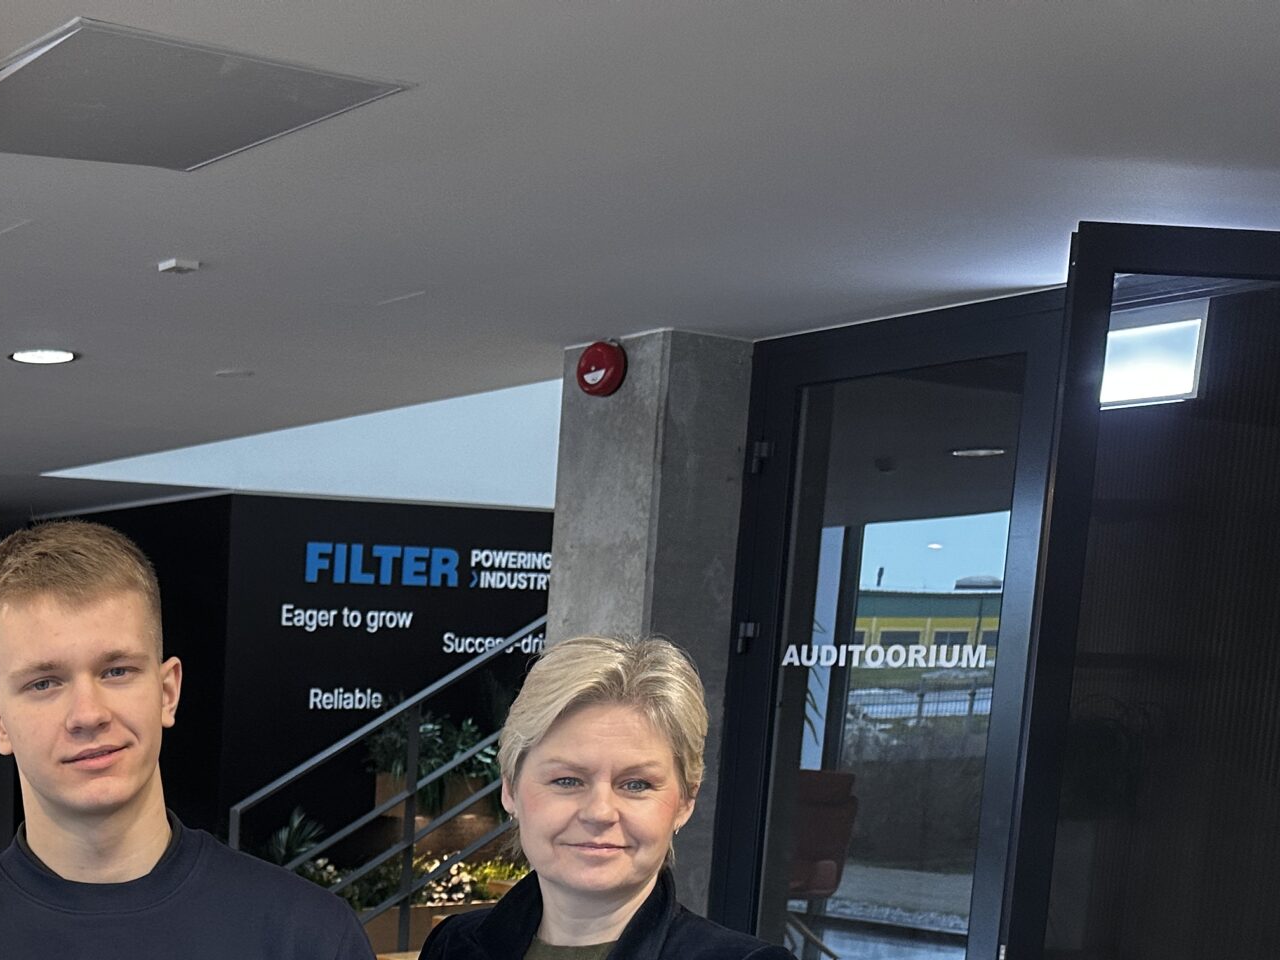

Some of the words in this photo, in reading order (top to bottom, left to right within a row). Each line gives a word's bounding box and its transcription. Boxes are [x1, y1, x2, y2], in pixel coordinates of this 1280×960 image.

[305, 542, 460, 587] FILTER
[470, 549, 552, 570] POWERING
[281, 604, 337, 631] Eager
[342, 608, 362, 628] to
[366, 611, 413, 633] grow
[781, 644, 987, 668] AUDITOORIUM
[309, 688, 382, 710] Reliable
